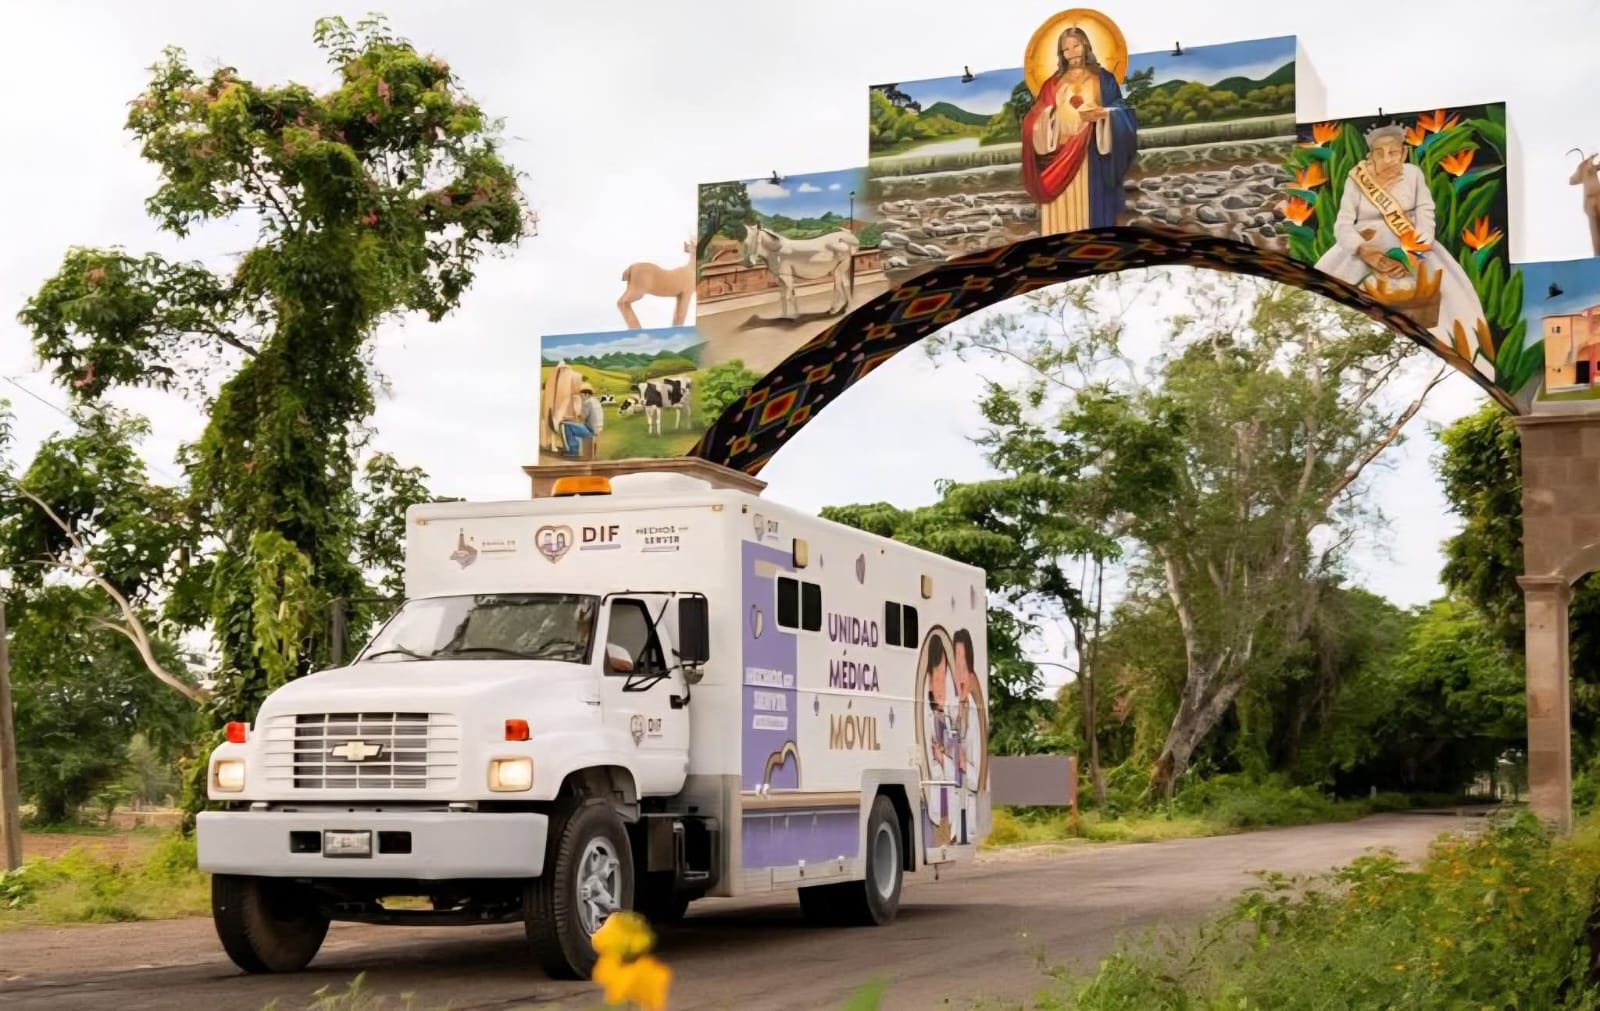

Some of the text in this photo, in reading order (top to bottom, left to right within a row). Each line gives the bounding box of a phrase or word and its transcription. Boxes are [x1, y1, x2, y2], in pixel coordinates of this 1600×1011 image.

[582, 525, 619, 542] DIF
[827, 612, 879, 648] UNIDAD
[828, 649, 880, 692] MÉDICA
[829, 699, 881, 751] MÓVIL
